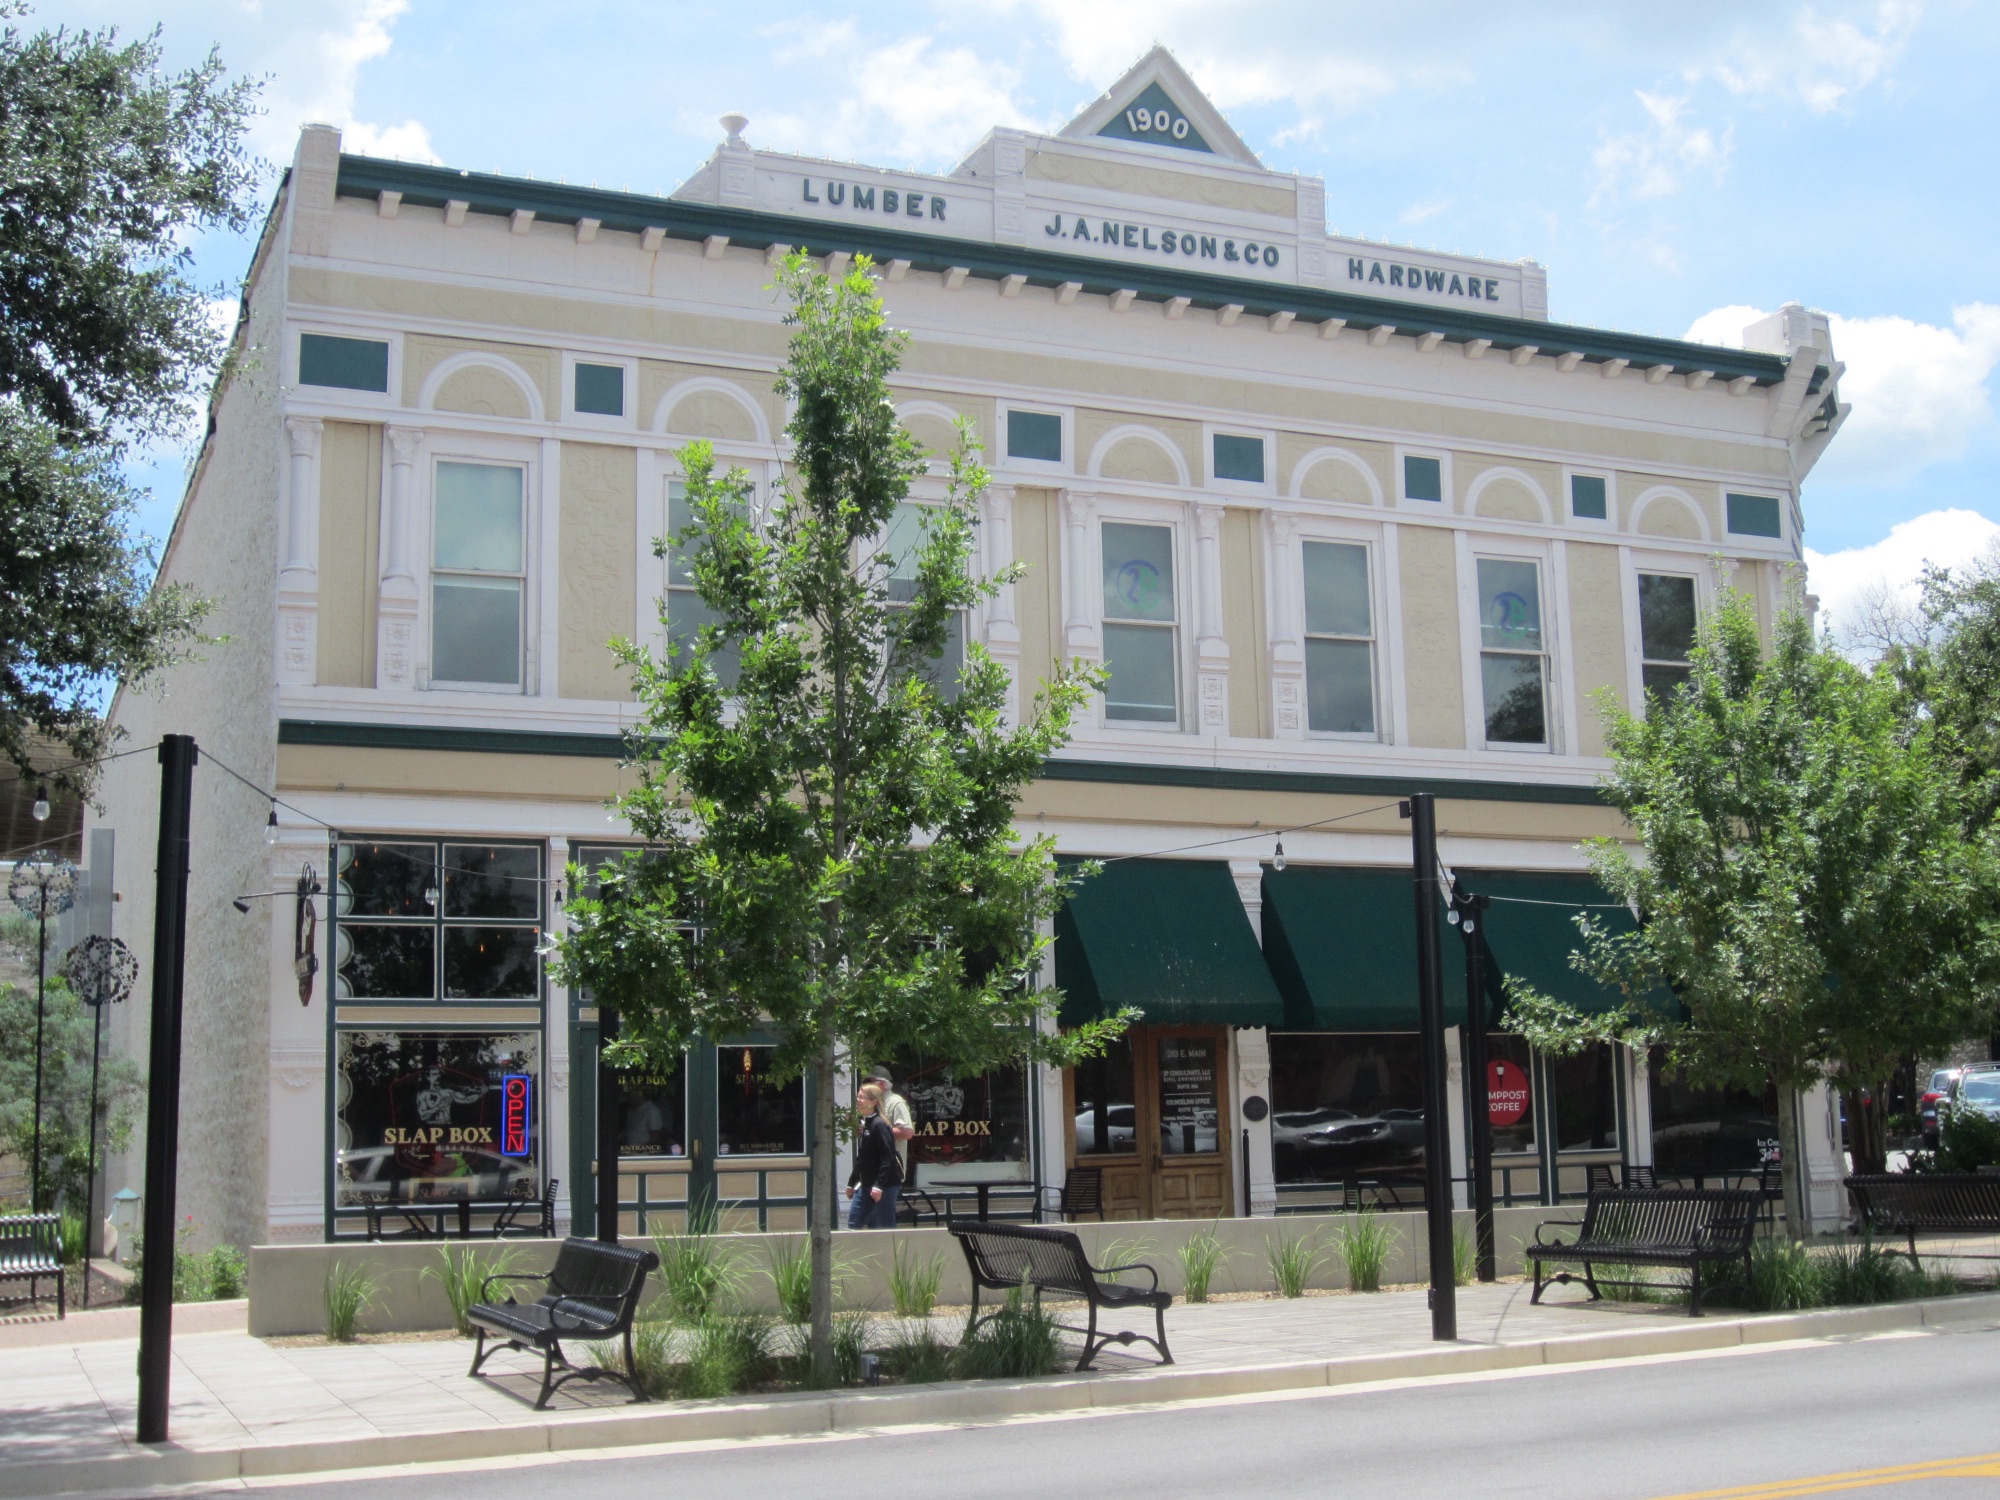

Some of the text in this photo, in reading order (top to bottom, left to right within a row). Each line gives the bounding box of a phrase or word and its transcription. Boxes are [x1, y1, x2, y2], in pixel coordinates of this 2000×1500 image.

[1126, 108, 1190, 140] 1900
[803, 178, 947, 221] LUMBER
[1348, 257, 1500, 301] HARDWARE
[1188, 1049, 1206, 1058] MAIN
[646, 1074, 667, 1086] BOX
[1488, 1090, 1526, 1100] MPPOST
[1488, 1102, 1520, 1112] OFFEE
[506, 1079, 526, 1152] OPEN
[912, 1120, 992, 1136] LAP BOX
[384, 1127, 493, 1144] SLAP BOX
[1767, 1137, 1781, 1147] CRE
[620, 1144, 662, 1152] ENTRANCE
